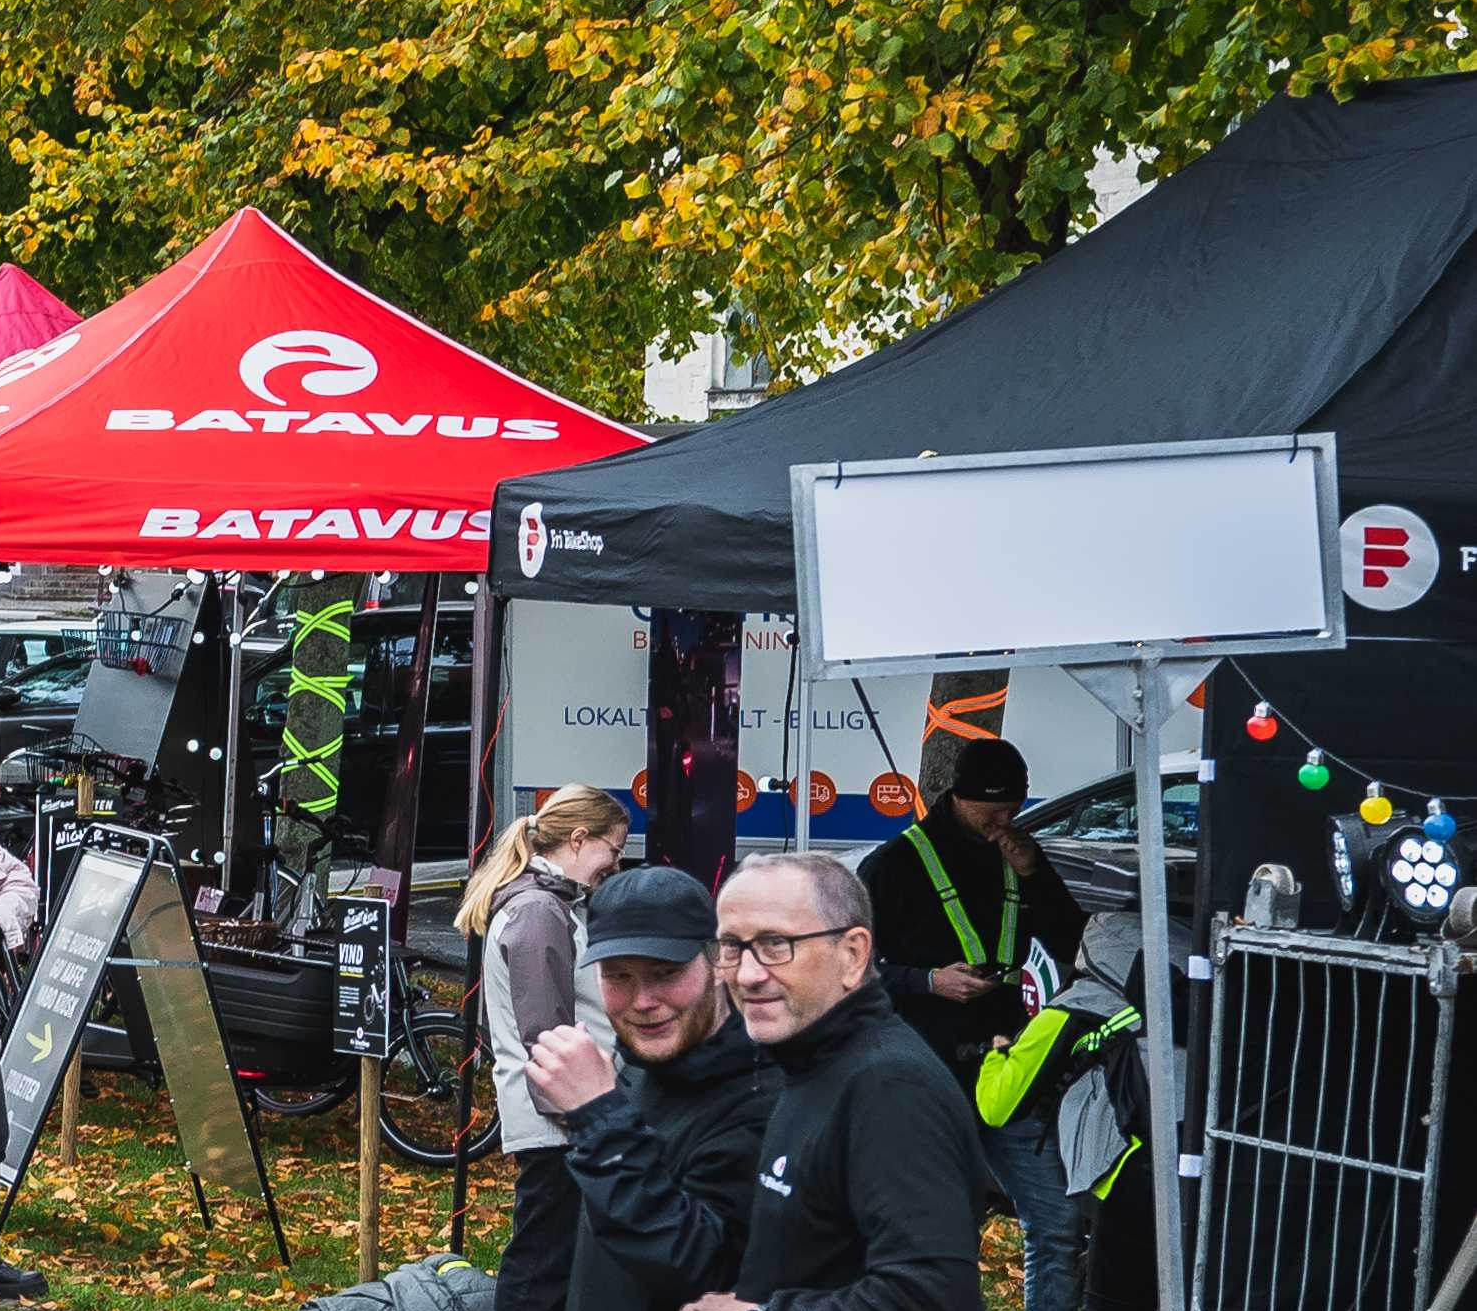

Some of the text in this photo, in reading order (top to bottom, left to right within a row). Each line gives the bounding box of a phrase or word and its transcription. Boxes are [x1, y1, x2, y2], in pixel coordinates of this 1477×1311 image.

[105, 409, 560, 441] BATAVUS
[550, 529, 604, 556] Fri BikeShop
[790, 710, 880, 730] BLLIGT
[339, 943, 364, 965] VIND
